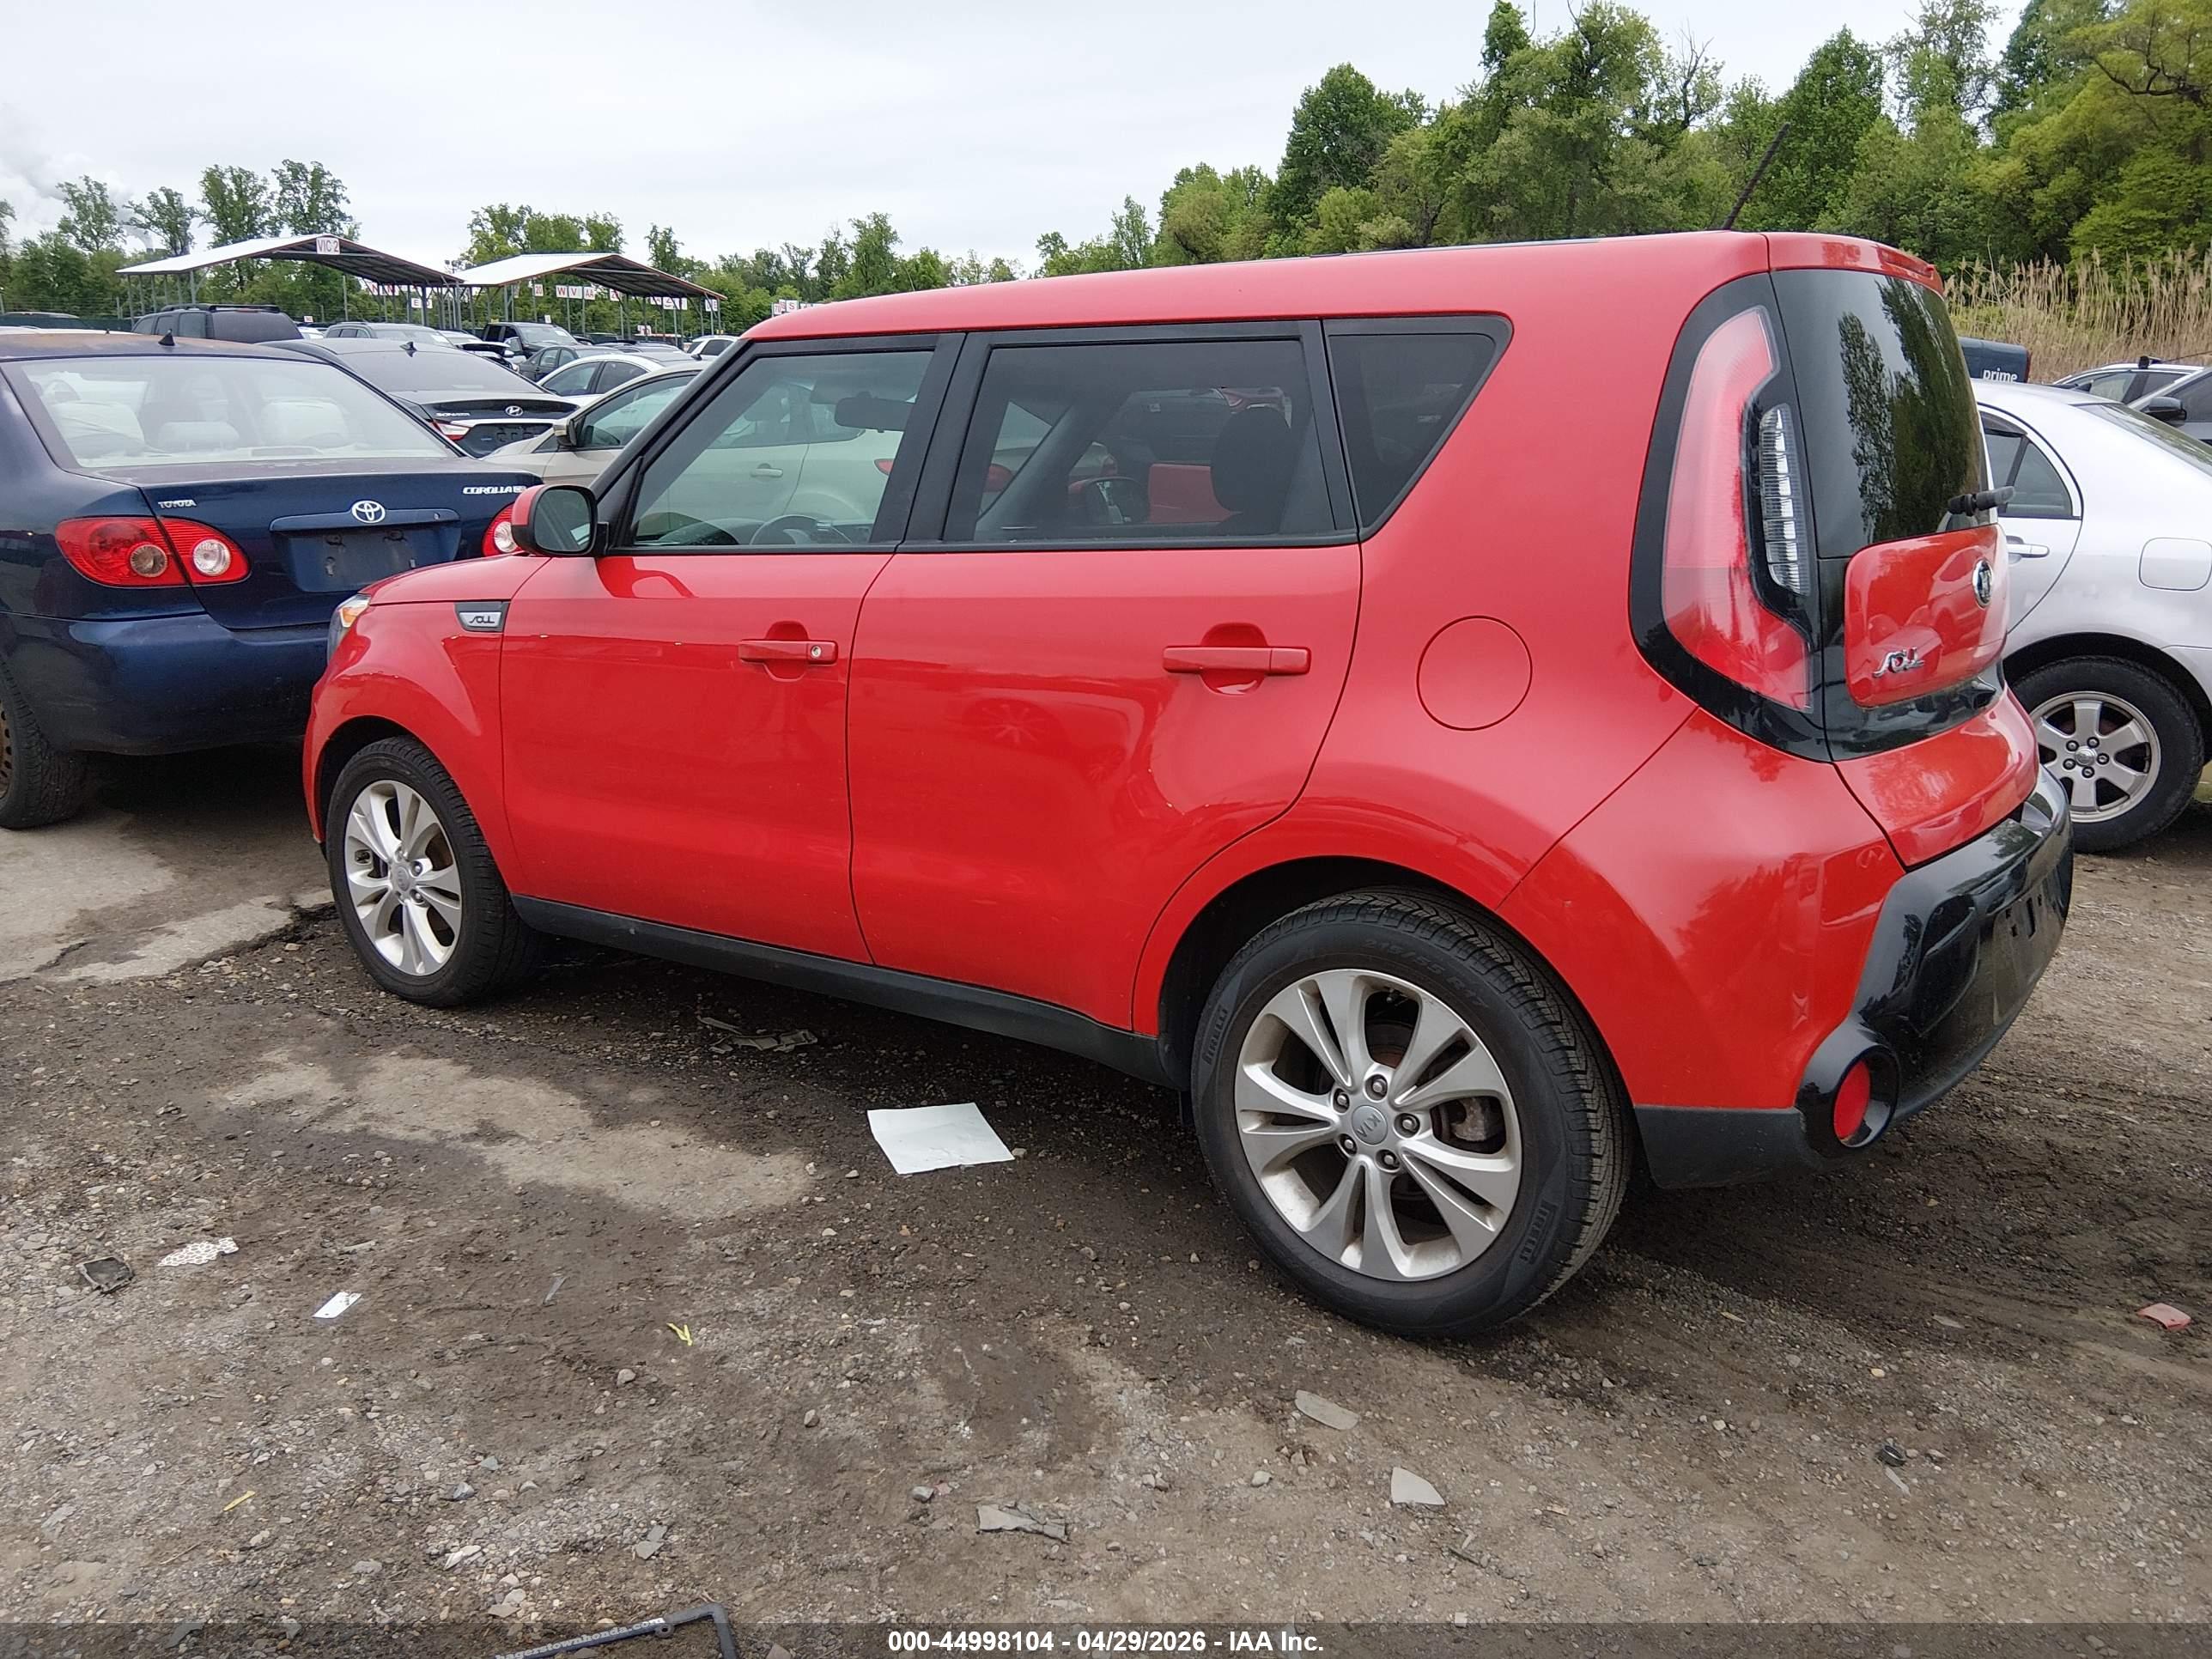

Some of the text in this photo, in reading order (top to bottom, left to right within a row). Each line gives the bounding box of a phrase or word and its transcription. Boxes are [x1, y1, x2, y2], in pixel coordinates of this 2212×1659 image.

[318, 240, 339, 252] VIC 2
[557, 287, 566, 295] W
[570, 288, 577, 296] V
[1983, 368, 2018, 383] prime
[463, 486, 513, 495] COROLLA
[157, 499, 197, 509] TOYOTA
[1357, 1113, 1381, 1137] KIA
